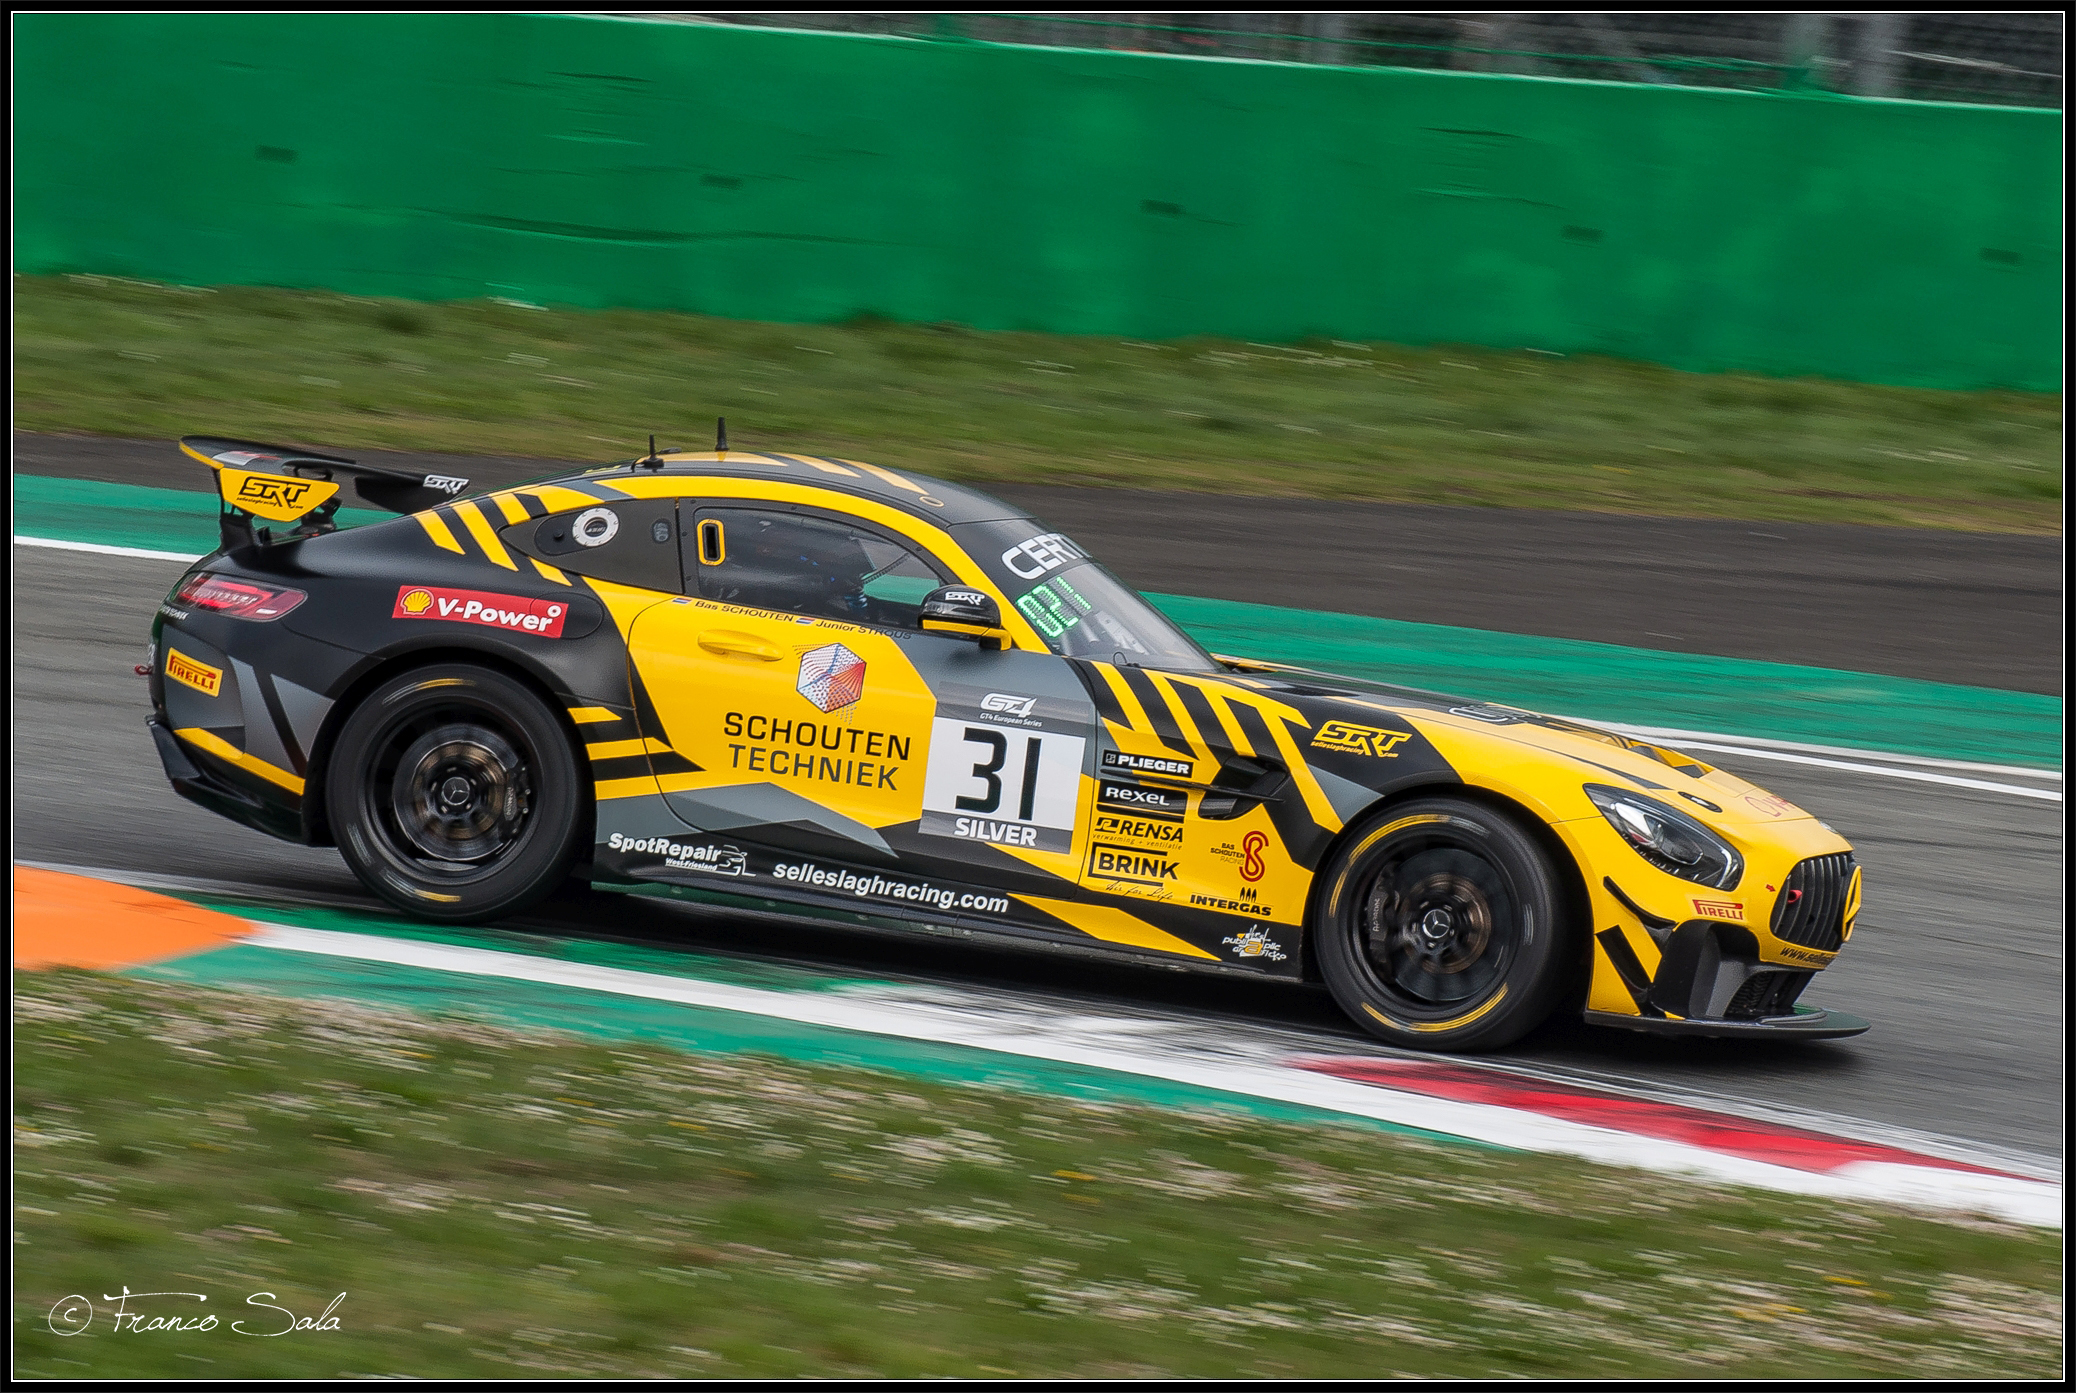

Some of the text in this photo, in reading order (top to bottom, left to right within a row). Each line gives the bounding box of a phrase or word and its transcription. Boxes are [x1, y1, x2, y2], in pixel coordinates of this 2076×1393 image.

[239, 476, 311, 508] SRT
[423, 474, 470, 494] SRT
[945, 591, 985, 606] SRT
[438, 597, 553, 632] V-Power
[695, 601, 794, 622] Bas SCHOUTEN
[816, 620, 912, 640] Junior STROUS
[168, 655, 217, 690] PIRELLI
[980, 693, 1037, 718] GT4
[993, 715, 1022, 725] European
[1022, 718, 1043, 727] Series
[724, 712, 911, 761] SCHOUTEN
[1313, 720, 1413, 758] SRT
[728, 743, 899, 791] TECHNIEK
[955, 727, 1042, 821] 31
[1117, 755, 1190, 774] PLIEGER
[954, 817, 1037, 847] SILVER
[1092, 833, 1135, 845] verwarming
[1119, 820, 1183, 843] RENSA
[608, 832, 722, 862] SpotRepair
[1210, 847, 1245, 859] SCHOUTEN
[1221, 842, 1235, 850] BAS
[1098, 852, 1180, 880] BRINK
[772, 863, 1009, 913] selleslaghracing.com
[1190, 894, 1272, 916] INTERGAS
[1692, 899, 1744, 920] PIRELLI
